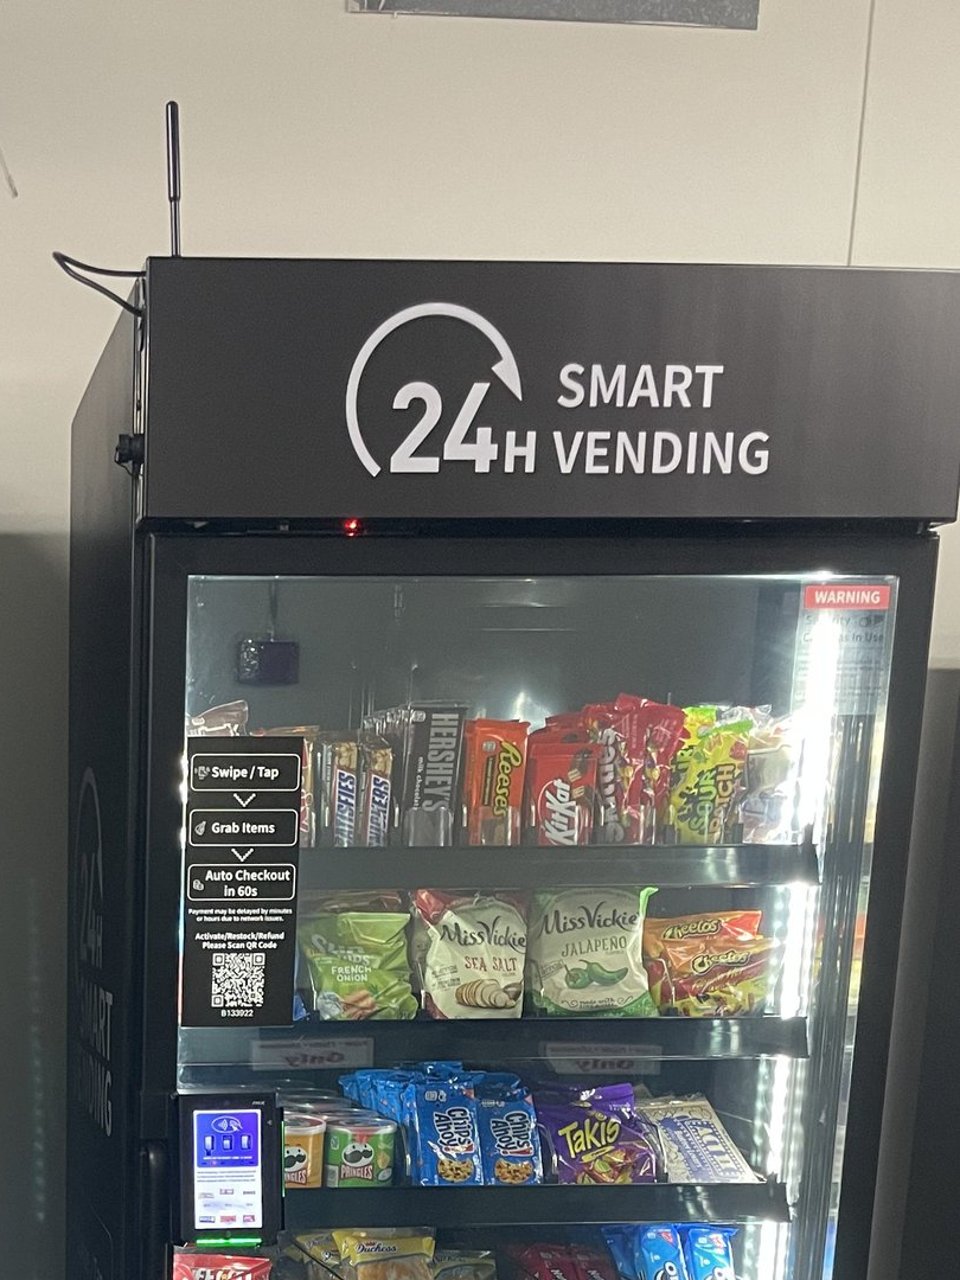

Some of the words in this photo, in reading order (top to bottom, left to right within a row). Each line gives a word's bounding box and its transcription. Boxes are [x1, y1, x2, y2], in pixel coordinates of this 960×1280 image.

[558, 364, 725, 408] SMART
[390, 382, 537, 473] 24H
[553, 431, 770, 475] VENDING
[815, 590, 881, 604] WARNING
[422, 713, 460, 812] HERSHEY'S
[210, 765, 248, 780] Swipe
[257, 766, 279, 780] Tap
[688, 766, 717, 835] SOUR
[211, 821, 239, 834] Grab
[241, 821, 276, 834] Items
[205, 870, 233, 881] Auto
[234, 869, 291, 881] Checkout
[223, 885, 236, 897] in
[237, 886, 258, 897] 60s
[541, 909, 584, 936] Miss
[662, 918, 721, 940] Cheetos
[195, 931, 285, 941] Activate/Restock/Refund
[441, 924, 485, 946] Miss
[202, 941, 226, 949] Please
[227, 941, 245, 949] Scan
[246, 941, 258, 949] QR
[258, 941, 278, 949] Code
[331, 965, 372, 975] FRENCH
[464, 956, 487, 972] SEA
[492, 957, 518, 972] SALT
[336, 973, 369, 982] ONION
[447, 1106, 474, 1148] Chips
[505, 1111, 533, 1149] Chips
[558, 1111, 622, 1159] Takis
[340, 1164, 373, 1180] PRINGLES
